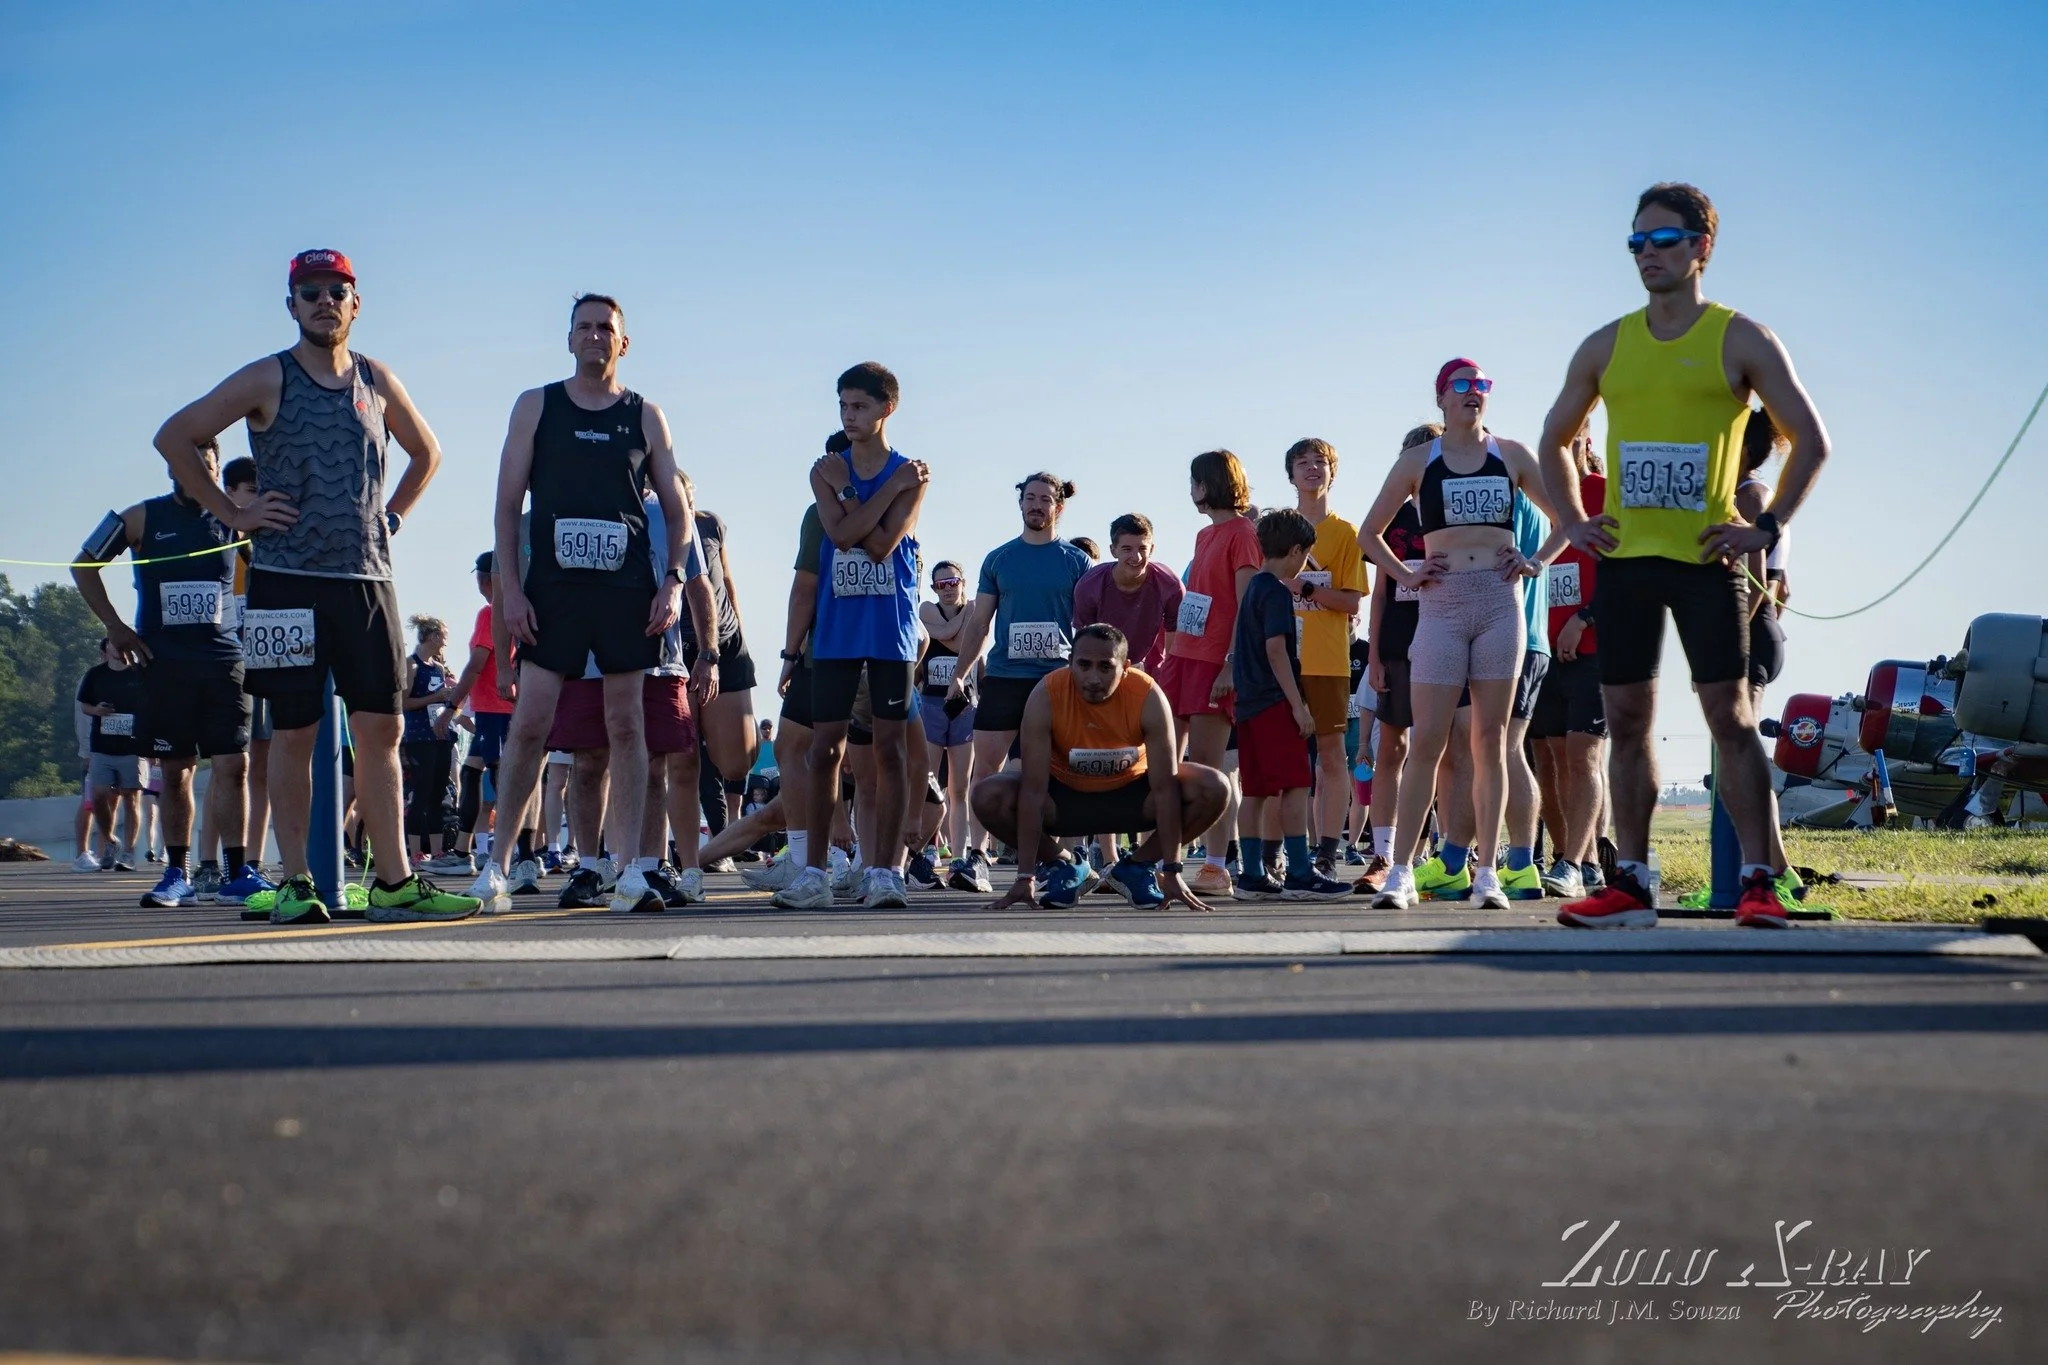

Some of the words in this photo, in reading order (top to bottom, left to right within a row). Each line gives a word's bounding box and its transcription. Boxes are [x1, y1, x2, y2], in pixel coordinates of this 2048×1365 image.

[1625, 460, 1696, 497] 5913
[1451, 488, 1505, 516] 5925
[560, 521, 623, 530] WWW.RUNCCRS.COM
[561, 532, 619, 561] 5915
[836, 560, 888, 587] 5920
[1553, 575, 1573, 598] 18
[167, 592, 217, 617] 5938
[244, 625, 304, 657] 5883
[1013, 632, 1054, 652] 5934
[1074, 750, 1134, 758] WWW.RUNCCRS.COM
